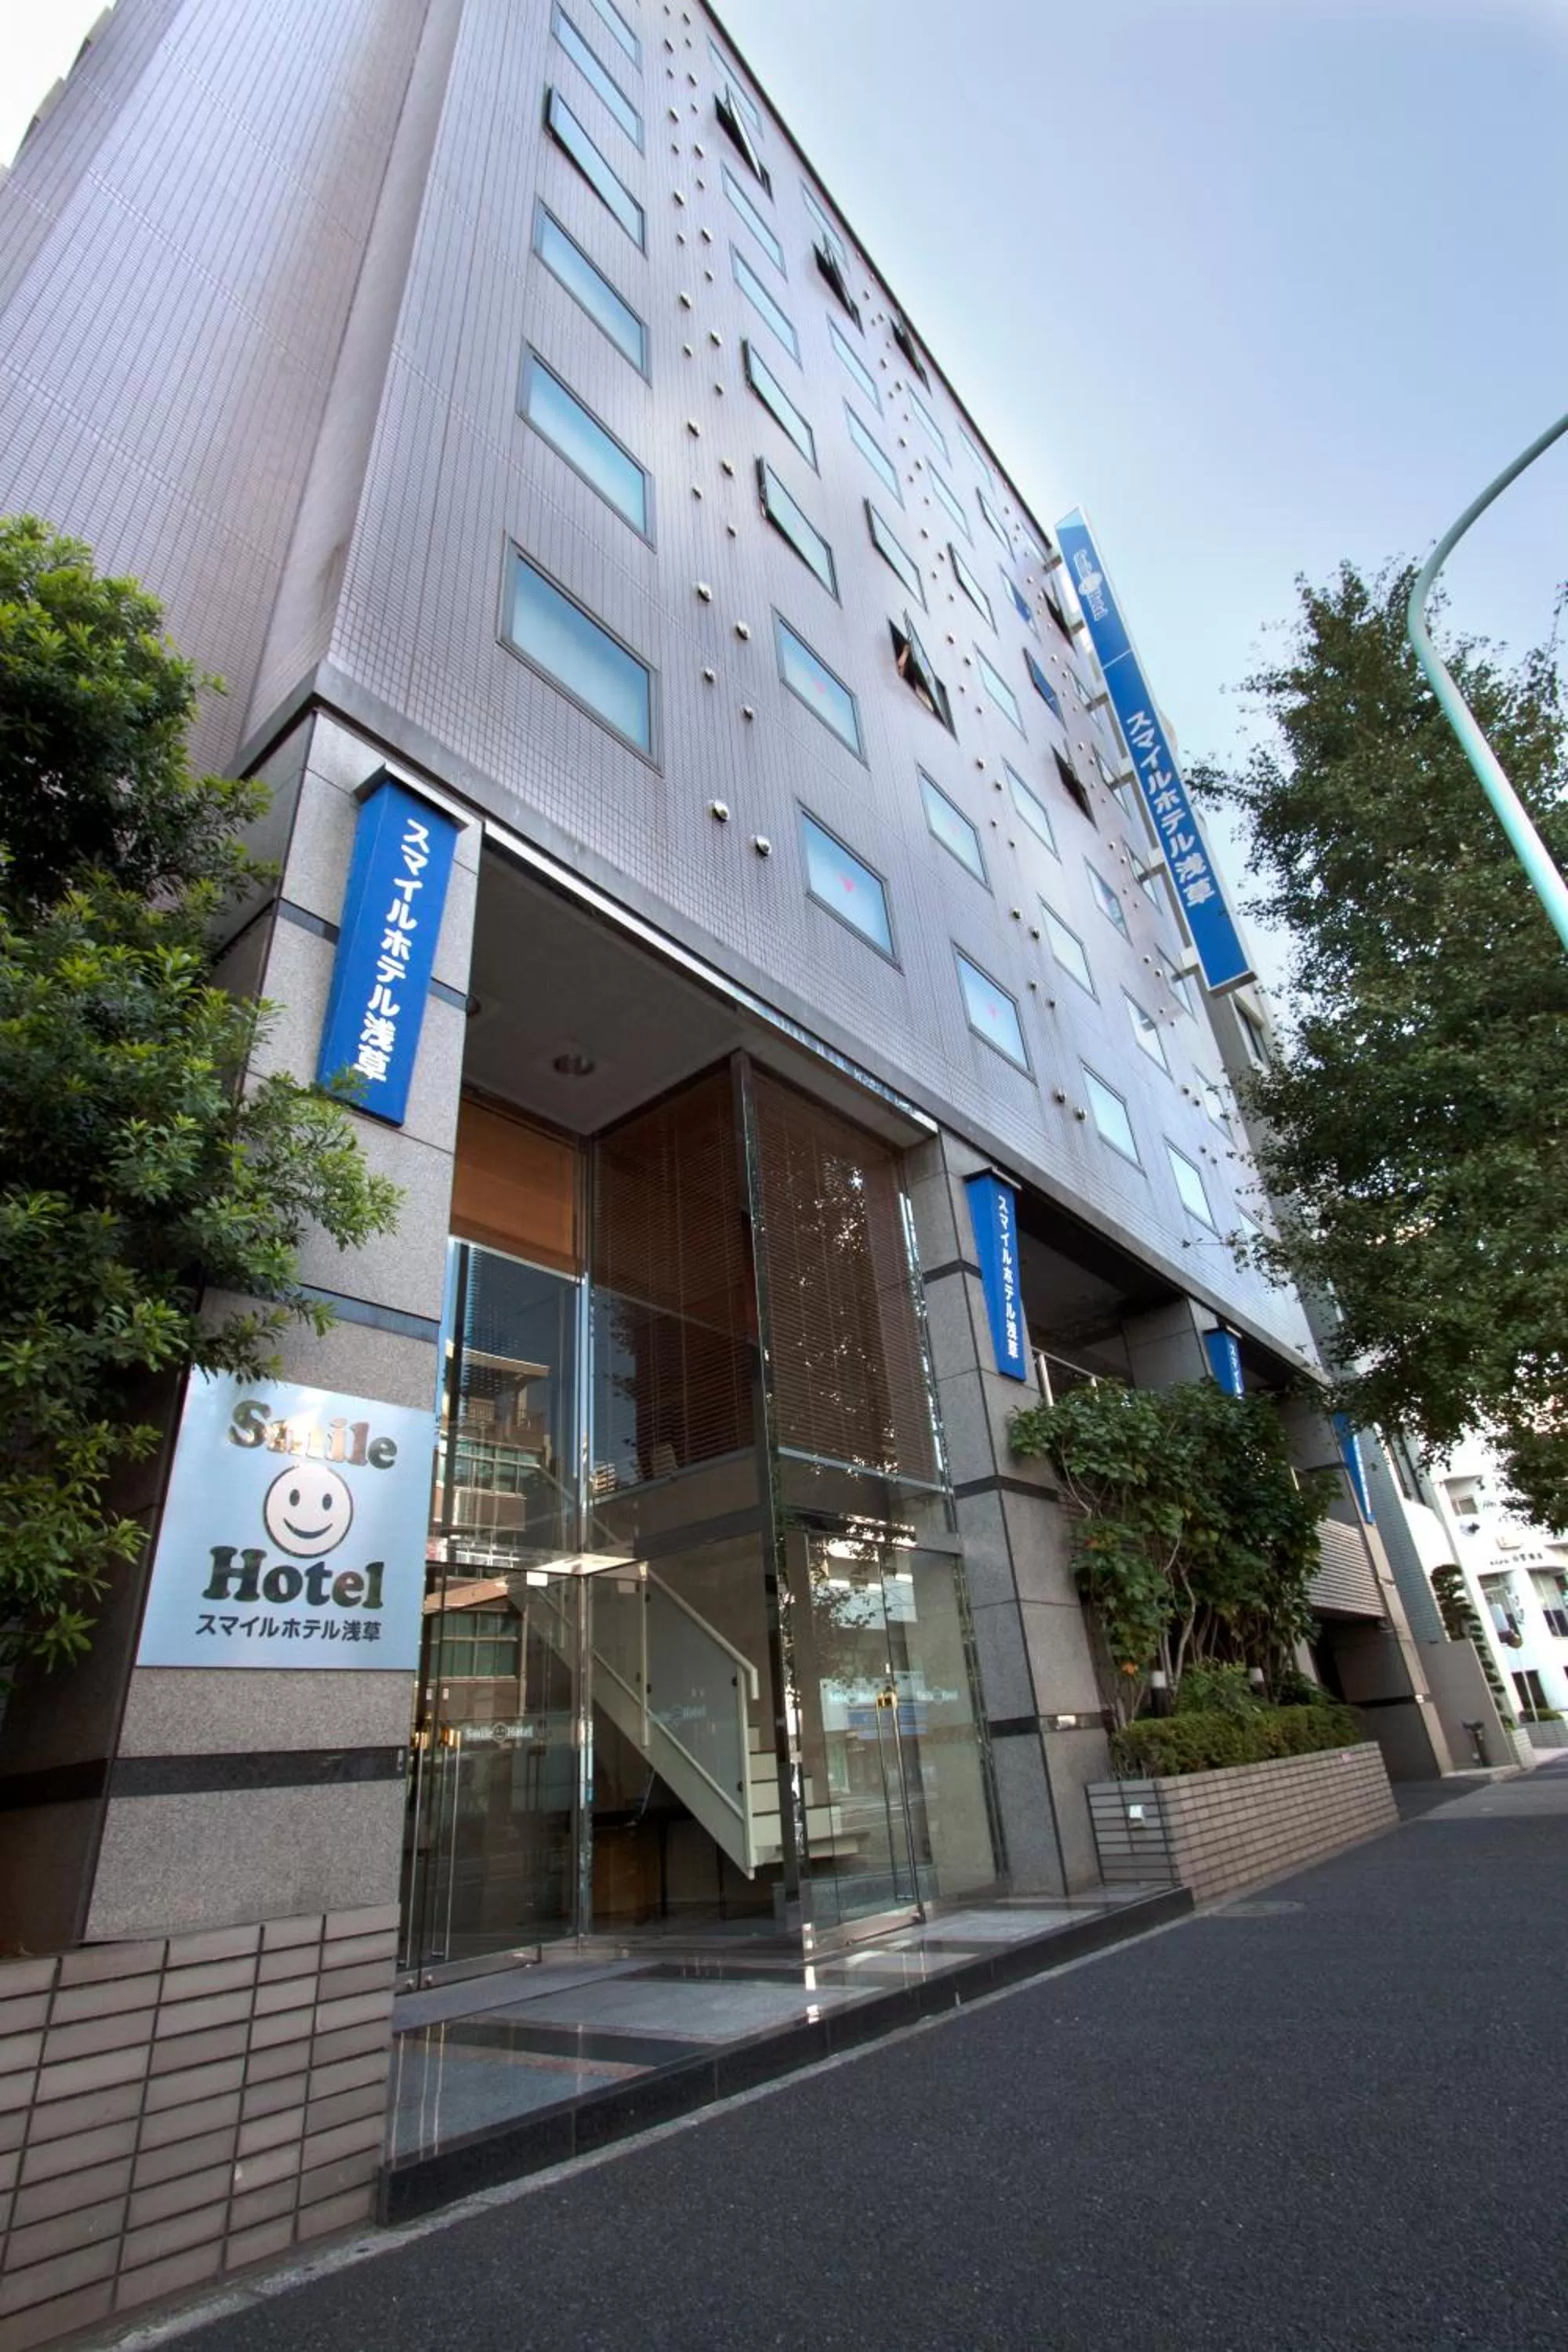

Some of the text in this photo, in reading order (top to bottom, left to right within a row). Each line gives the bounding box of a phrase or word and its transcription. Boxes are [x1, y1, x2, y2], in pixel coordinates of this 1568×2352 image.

[1127, 710, 1215, 907] スマイルホテル浅草
[354, 818, 430, 1083] スマイルホテル浅草
[195, 1613, 382, 1642] スマイルホテル浅草
[201, 1545, 385, 1609] Hotel
